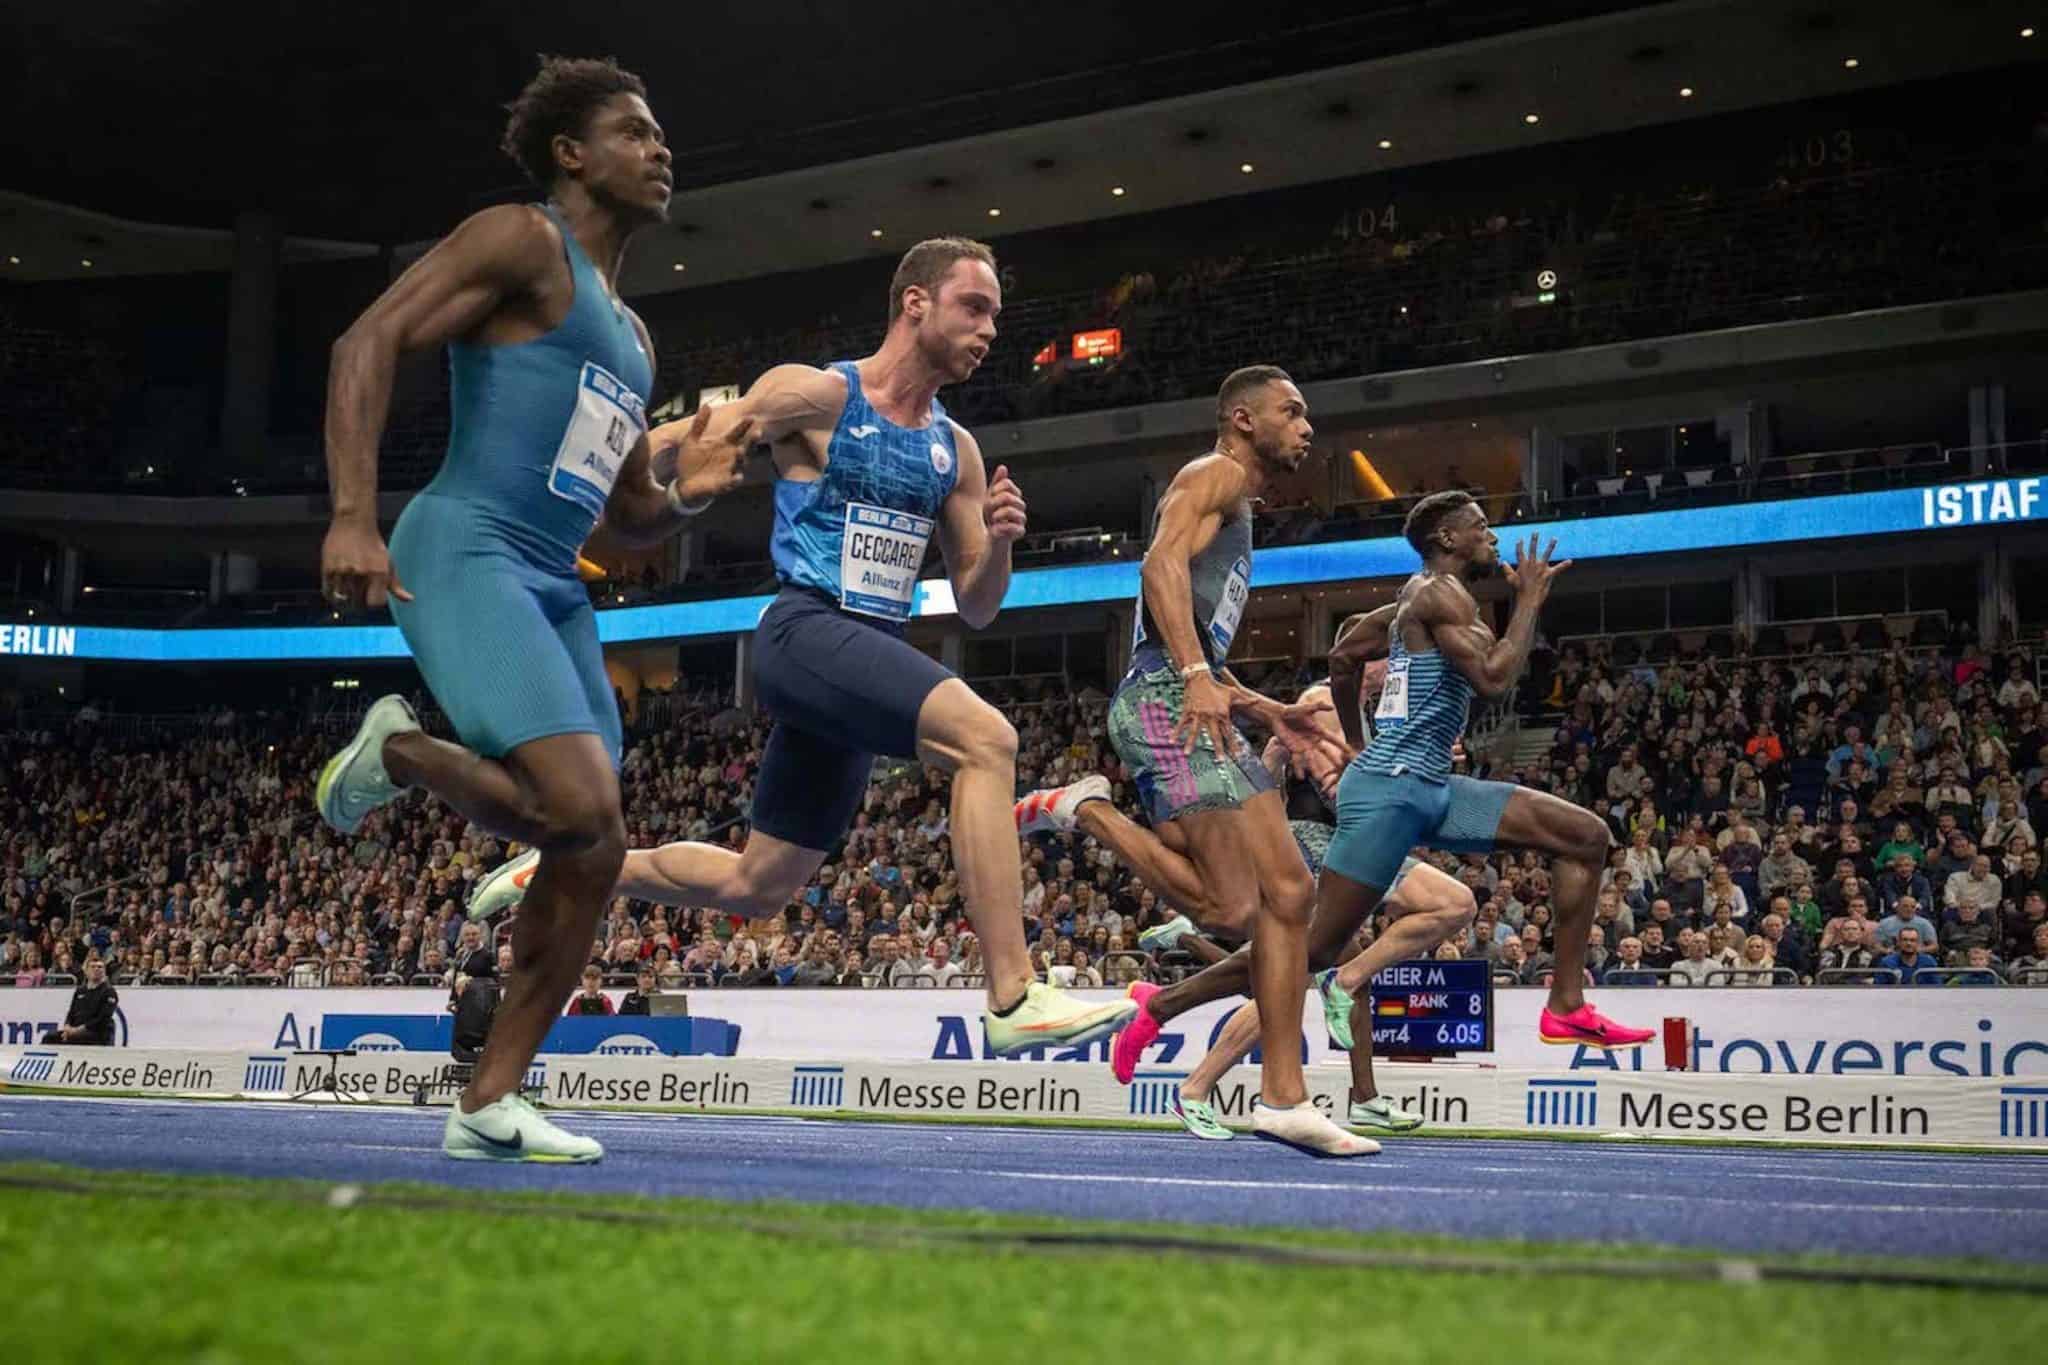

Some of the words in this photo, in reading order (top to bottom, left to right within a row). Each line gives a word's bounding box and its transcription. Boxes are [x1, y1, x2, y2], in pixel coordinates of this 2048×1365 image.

[1333, 203, 1397, 238] 404
[1924, 479, 2040, 527] ISTAF
[861, 570, 900, 592] Allianz
[1427, 967, 1446, 985] M
[1408, 994, 1448, 1008] RANK
[1469, 993, 1482, 1015] 8
[1436, 1023, 1481, 1044] 6.05
[59, 1060, 136, 1085] Messe
[142, 1061, 213, 1089] Berlin
[557, 1071, 651, 1101] Messe
[660, 1072, 750, 1104] Berlin
[858, 1076, 966, 1109] Messe
[977, 1078, 1080, 1112] Berlin
[1620, 1093, 1768, 1131] Messe
[1784, 1095, 1929, 1136] Berlin
